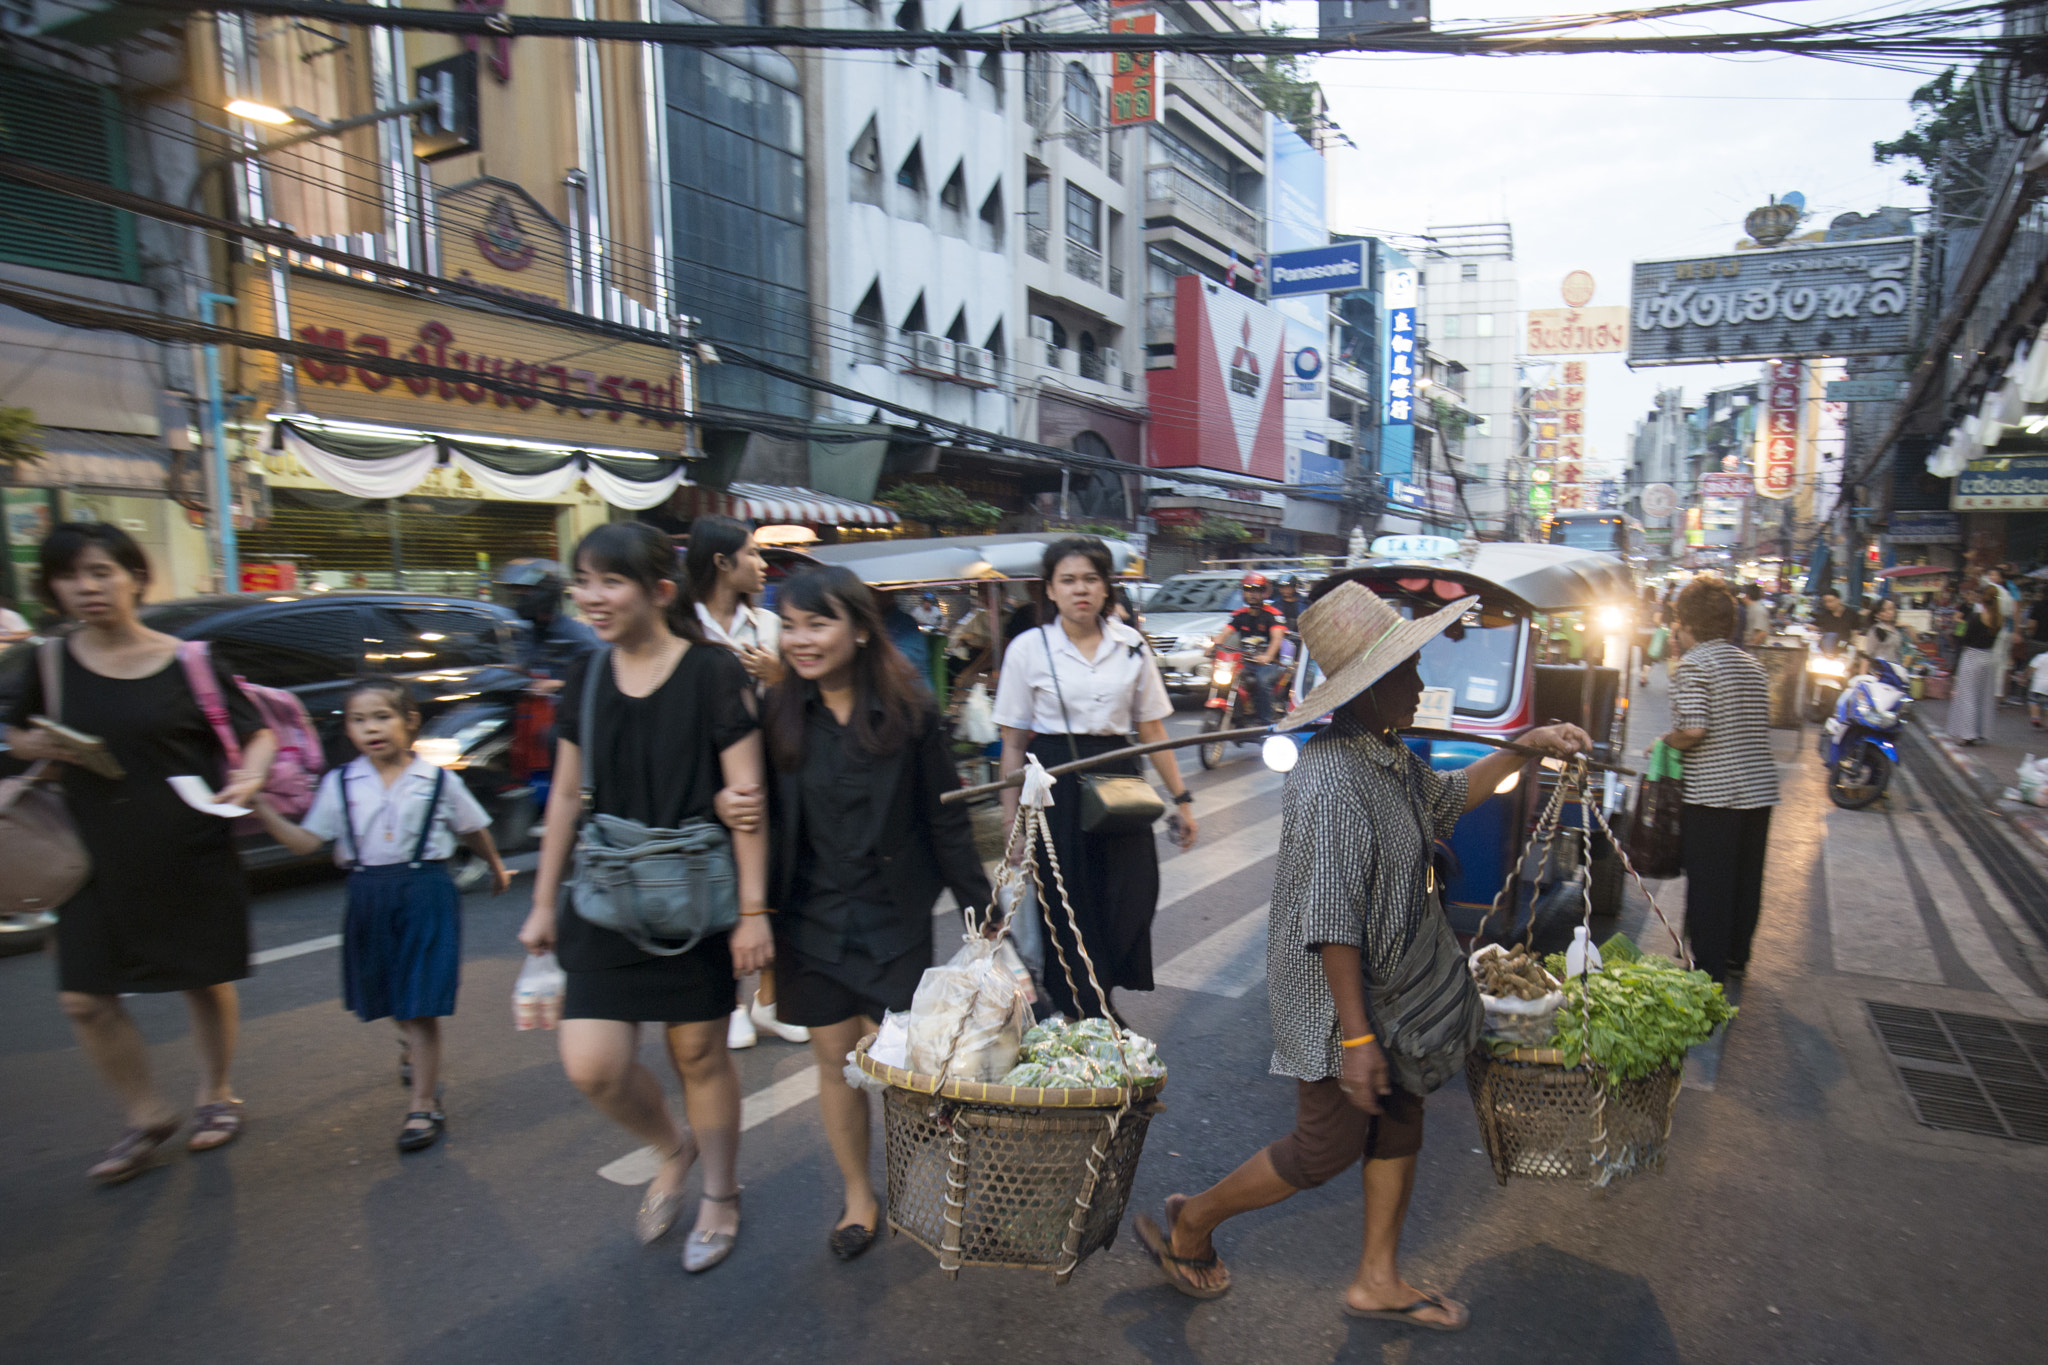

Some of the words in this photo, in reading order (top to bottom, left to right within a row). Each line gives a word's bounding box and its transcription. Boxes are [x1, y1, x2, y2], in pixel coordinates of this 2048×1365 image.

[1272, 258, 1361, 284] Panasonic
[1637, 255, 1911, 331] เซ่งเฮงหลี
[1388, 538, 1440, 552] TAXI
